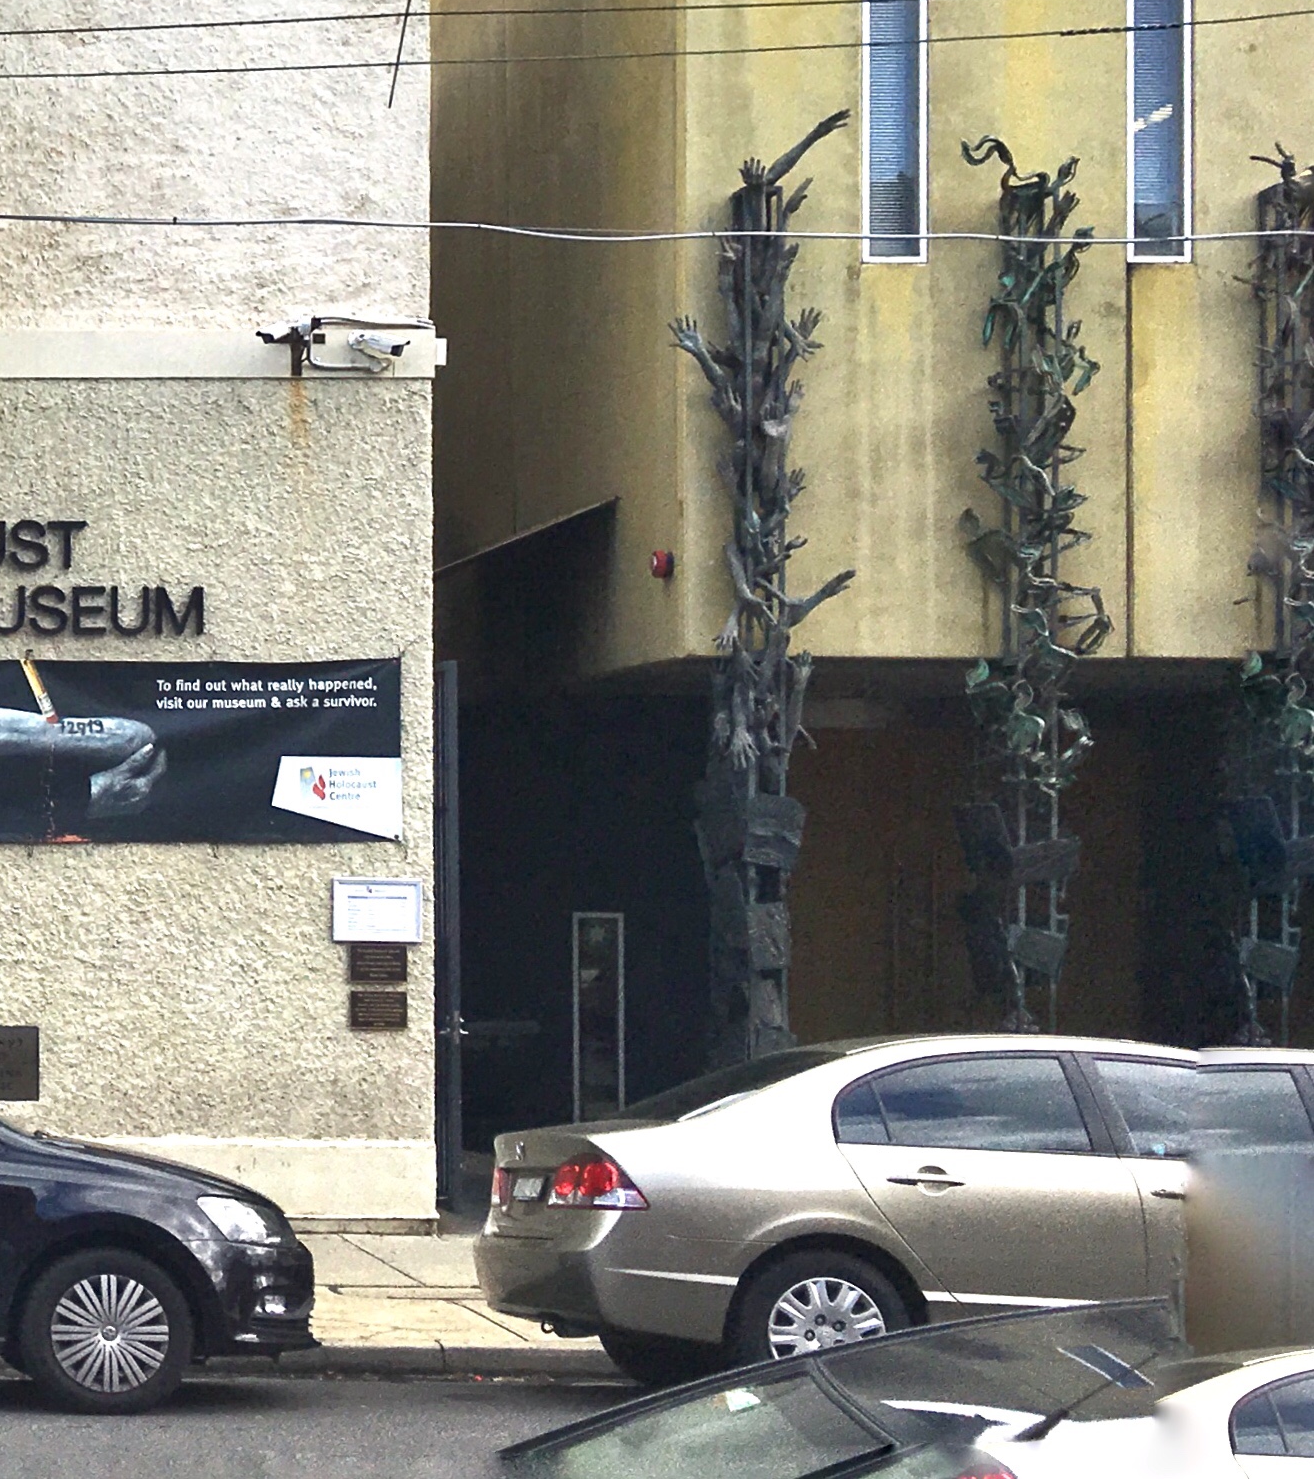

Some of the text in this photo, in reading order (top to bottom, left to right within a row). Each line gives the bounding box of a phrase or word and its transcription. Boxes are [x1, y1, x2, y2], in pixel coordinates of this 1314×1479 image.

[156, 677, 377, 693] To find out what really happened,
[156, 695, 377, 709] visit our museum & ask a survivor.
[329, 768, 361, 777] Jewish
[329, 780, 377, 789] Holocaust
[329, 791, 361, 800] Centre
